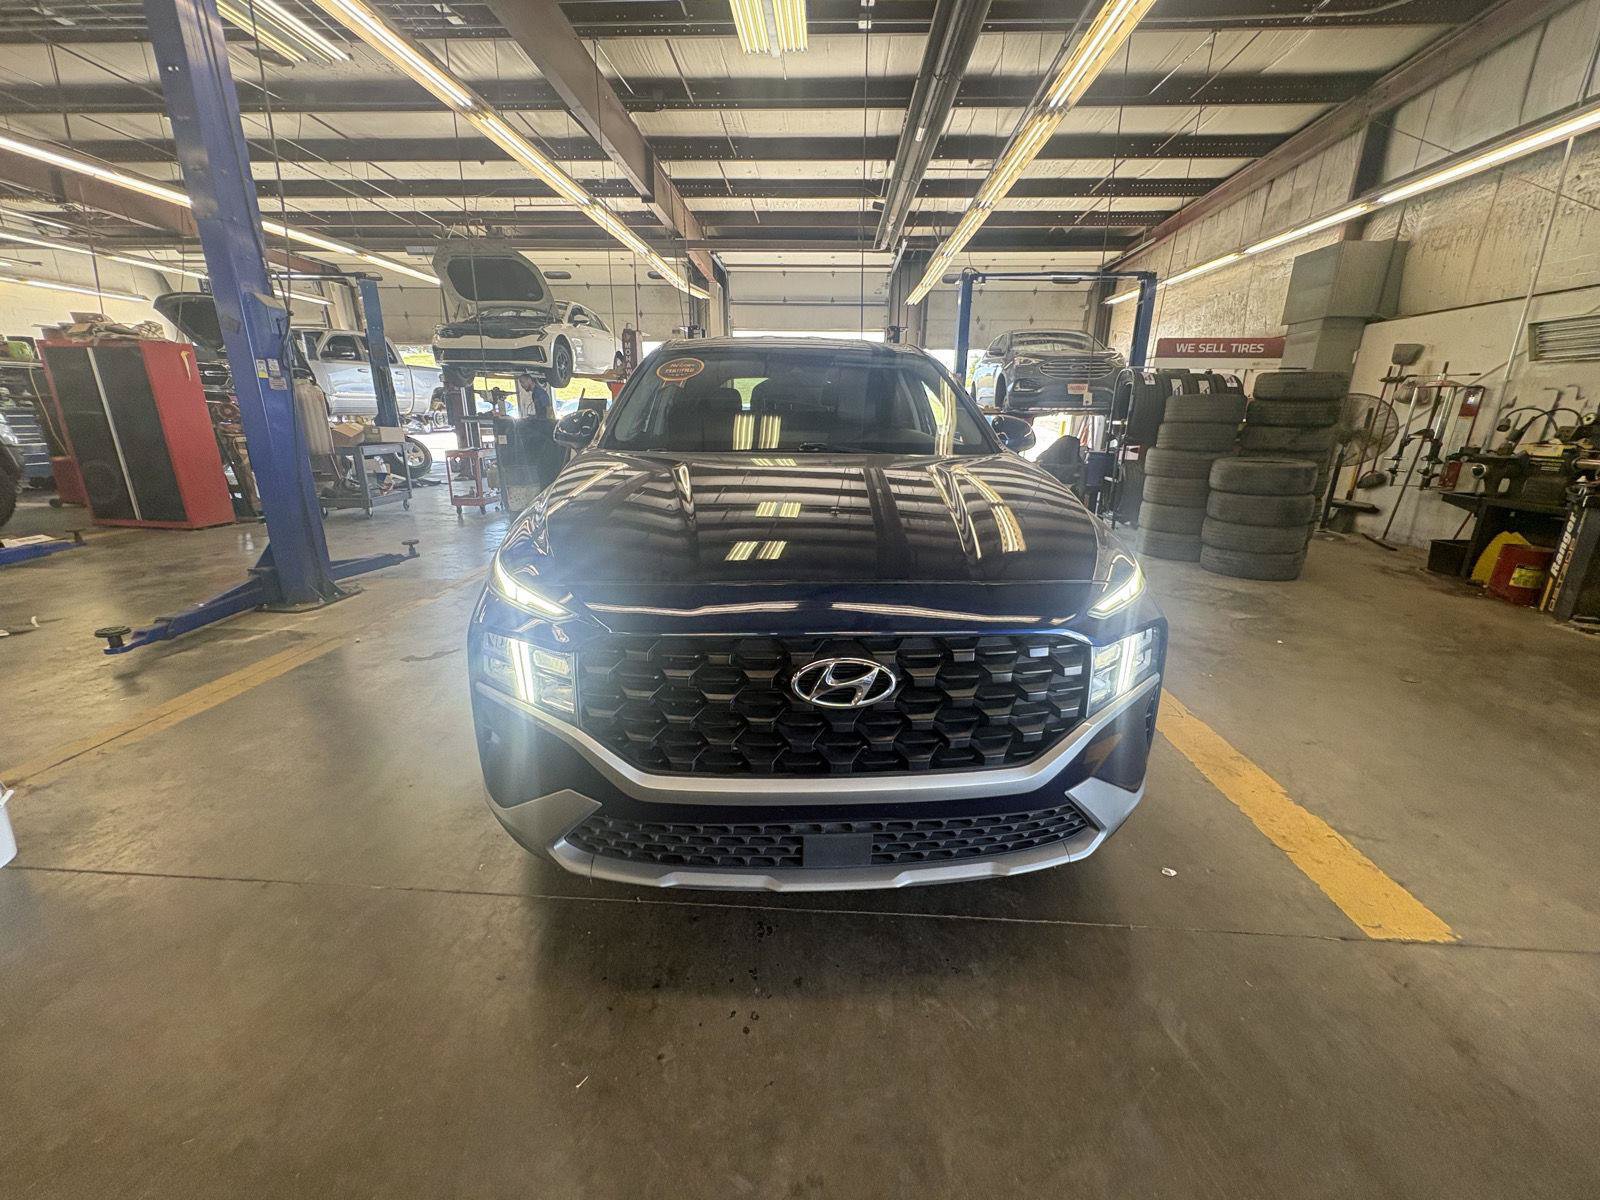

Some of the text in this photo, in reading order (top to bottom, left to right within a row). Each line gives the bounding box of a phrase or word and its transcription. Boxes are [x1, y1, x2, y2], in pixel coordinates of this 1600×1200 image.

[1175, 343, 1265, 353] WE SELL TIRES
[1550, 512, 1576, 577] Ranger
